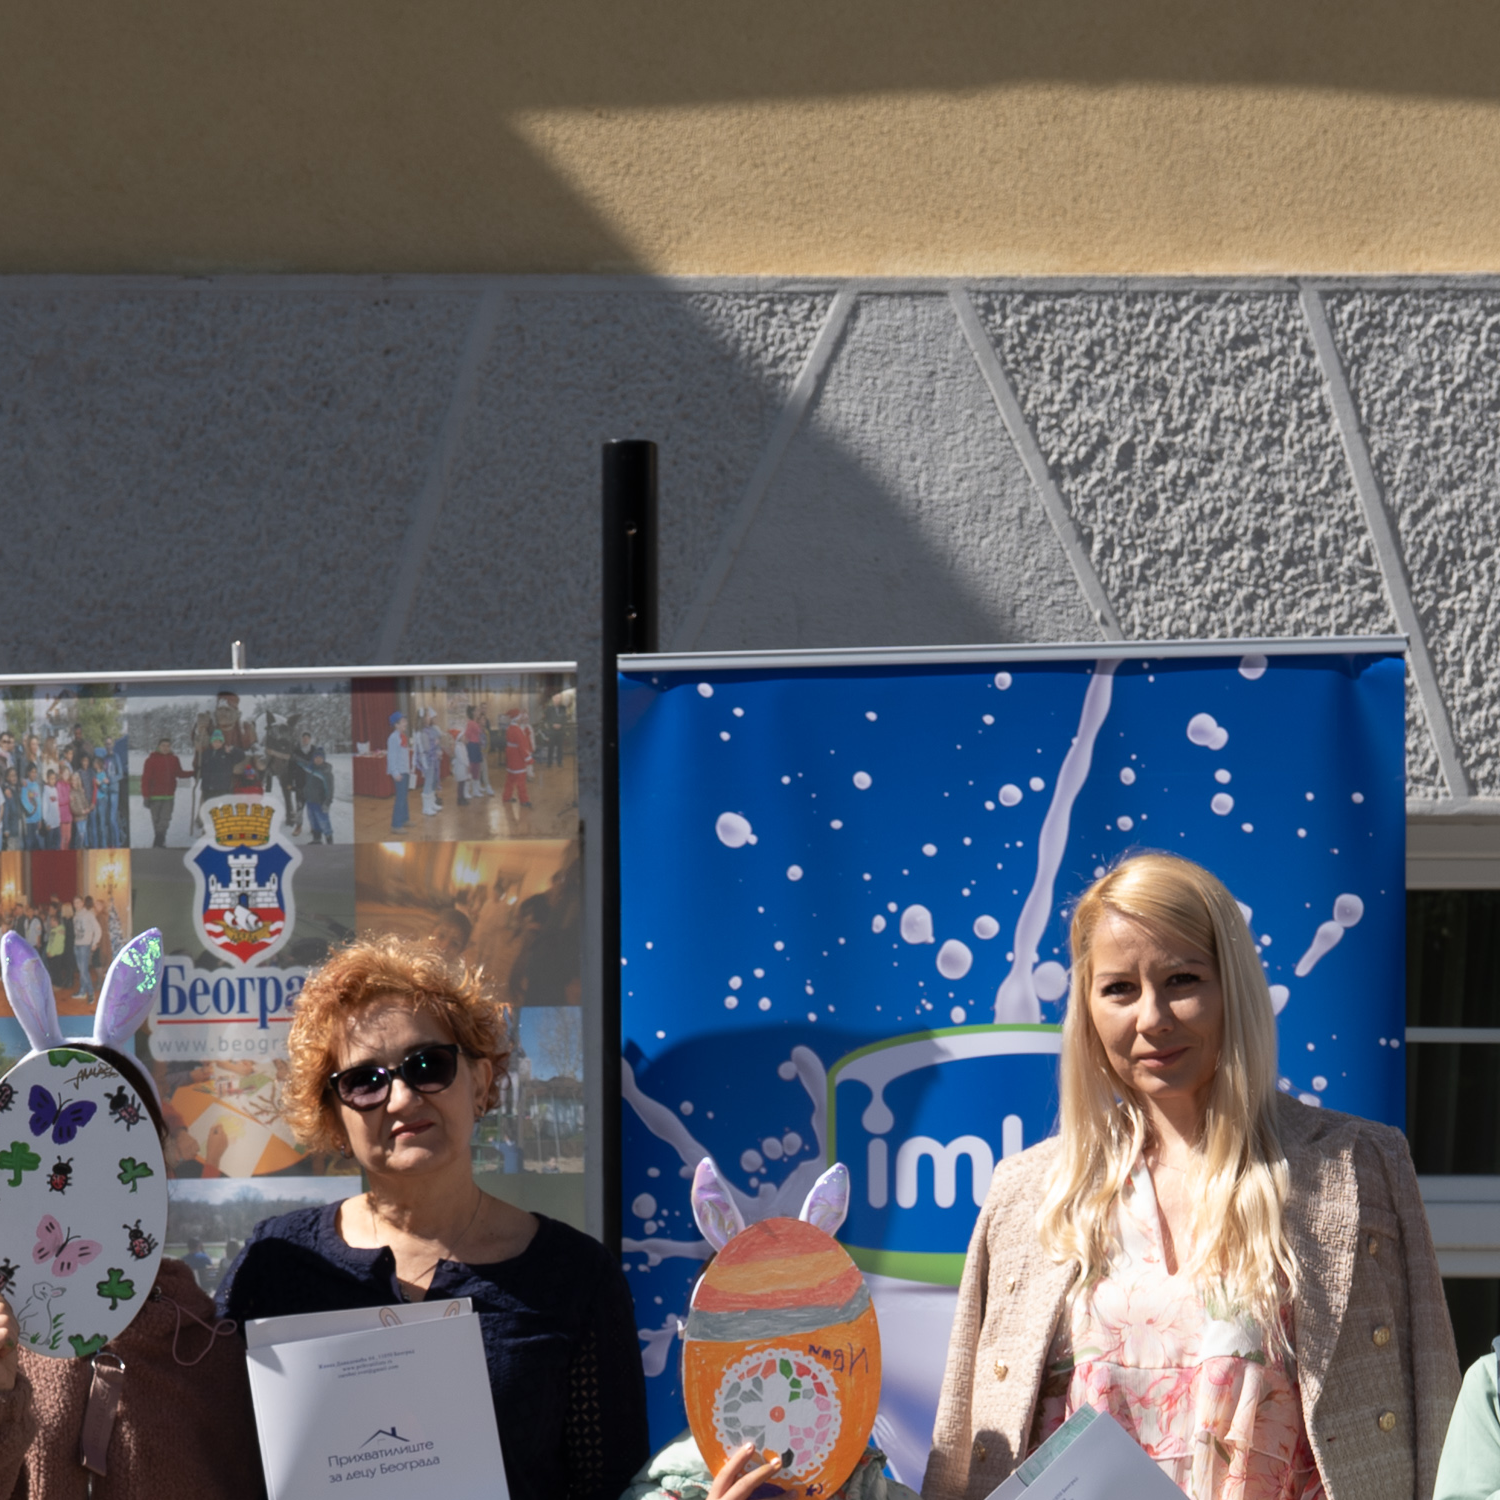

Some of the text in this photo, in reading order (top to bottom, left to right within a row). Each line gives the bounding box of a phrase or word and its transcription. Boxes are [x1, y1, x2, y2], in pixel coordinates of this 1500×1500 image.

[328, 1440, 434, 1468] Прихватилиште
[329, 1455, 441, 1484] за децу Београда
